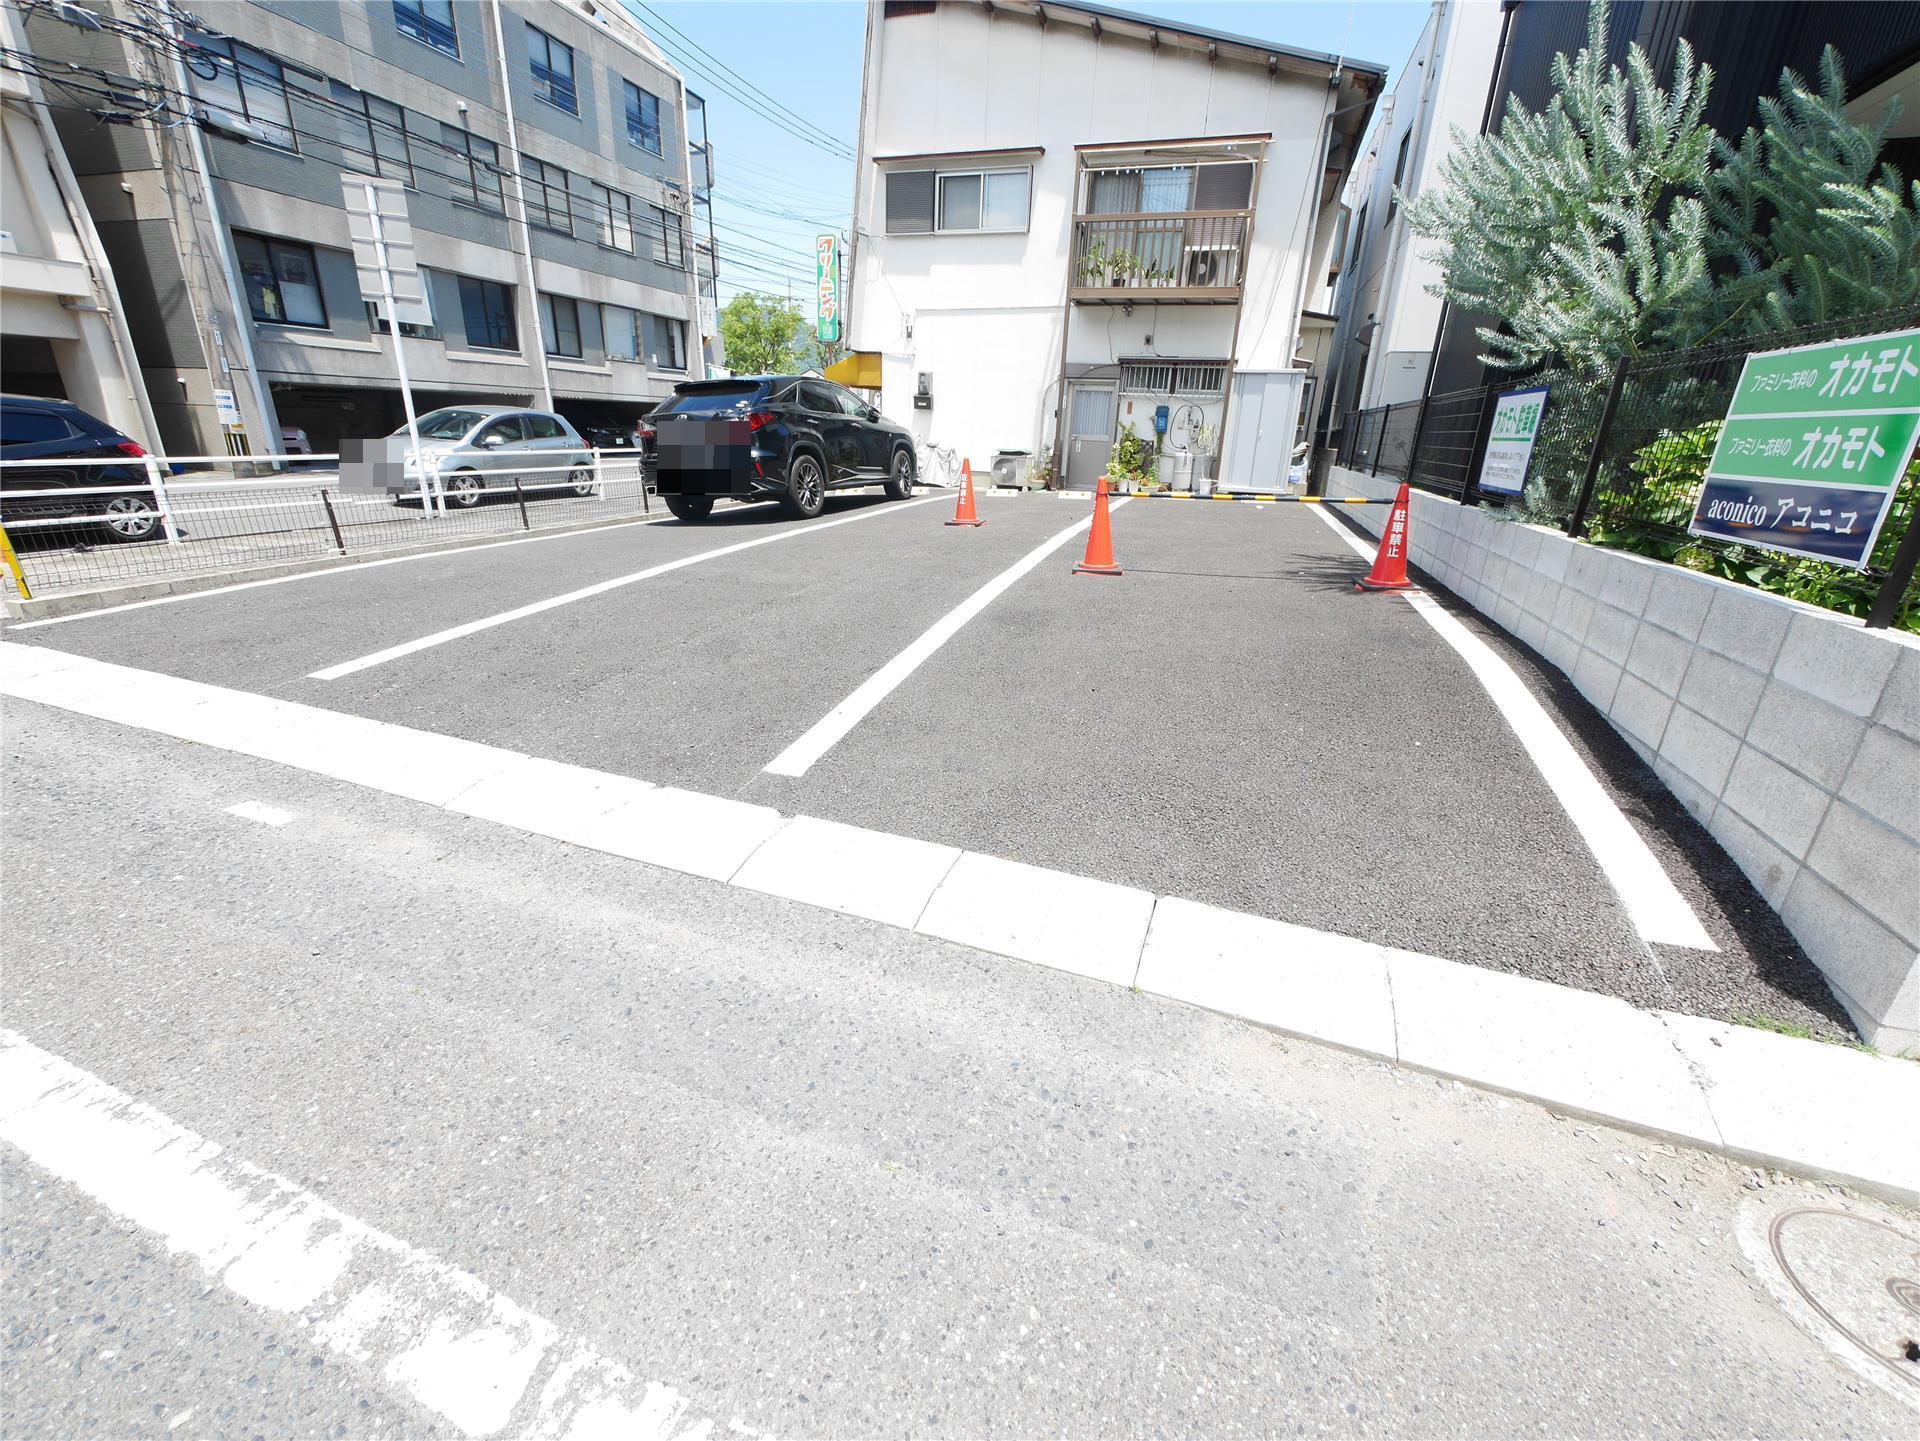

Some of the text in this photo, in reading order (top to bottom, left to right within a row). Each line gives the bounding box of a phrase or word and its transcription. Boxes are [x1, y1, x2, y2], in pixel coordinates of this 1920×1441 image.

[818, 238, 836, 320] クリーニング
[1818, 344, 1919, 398] オカモト
[1792, 425, 1885, 472] オカモト
[1387, 509, 1407, 558] 駐車禁止
[1707, 495, 1858, 534] aconico アコニコ
